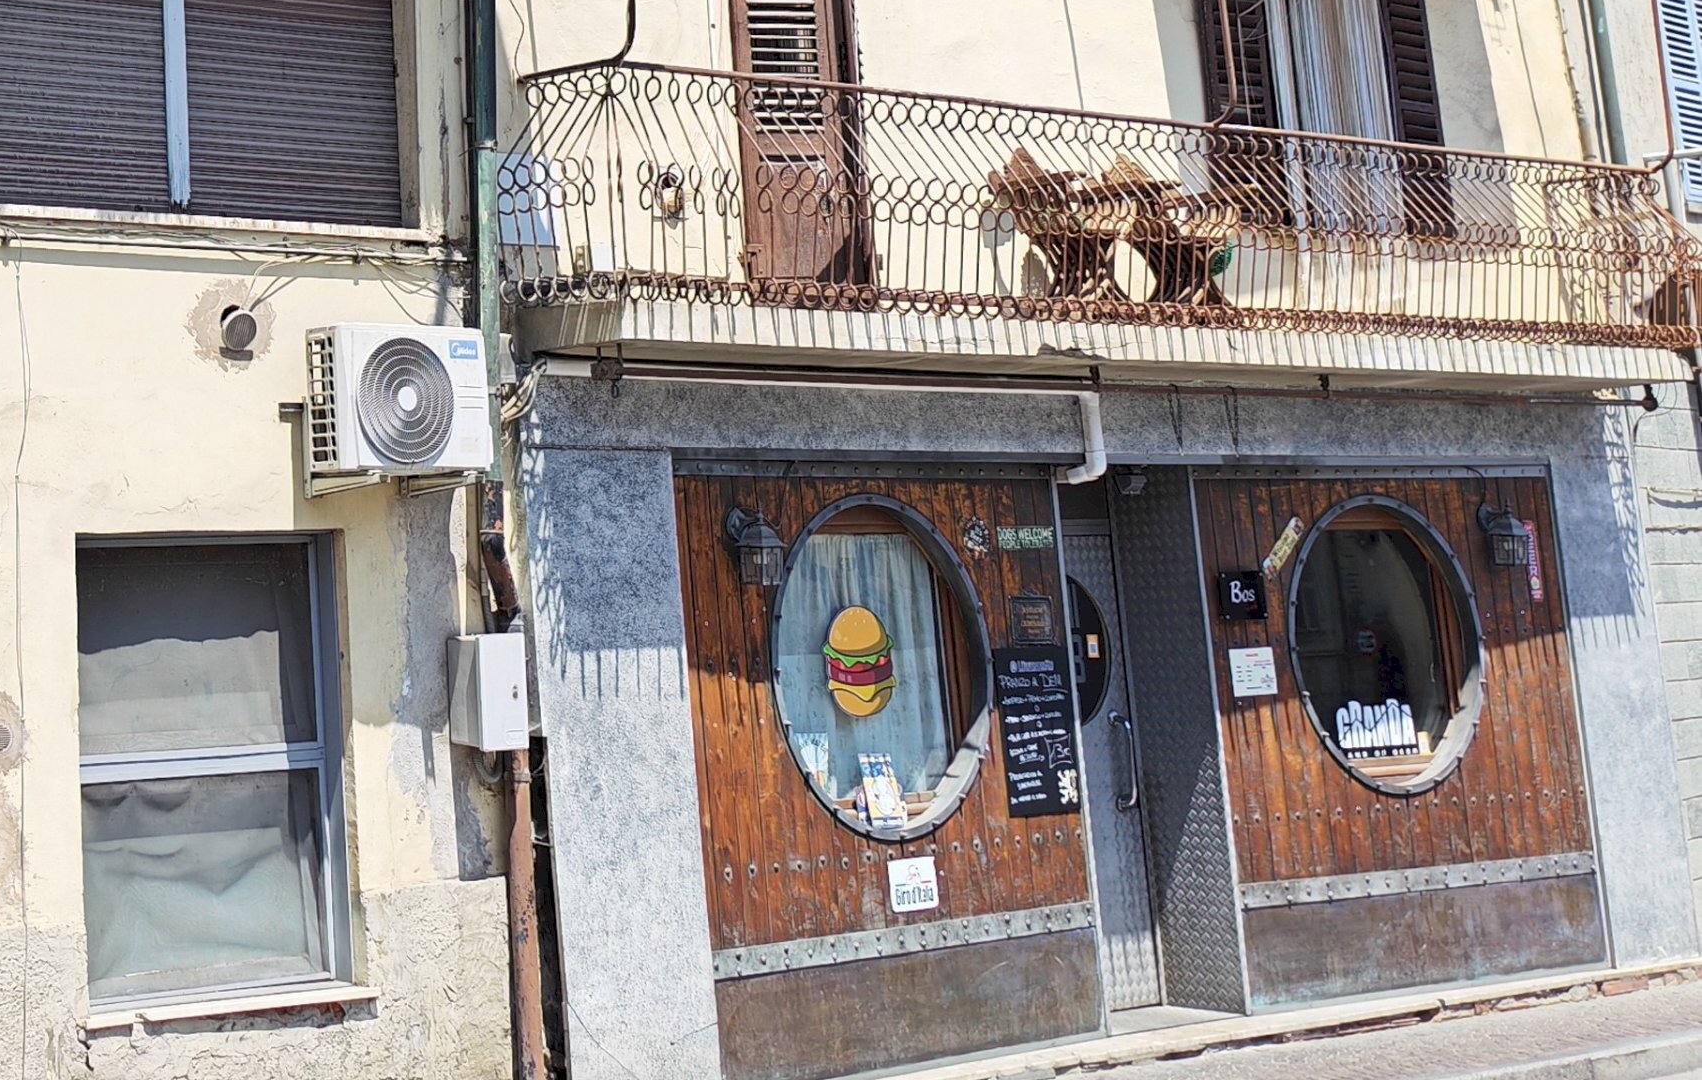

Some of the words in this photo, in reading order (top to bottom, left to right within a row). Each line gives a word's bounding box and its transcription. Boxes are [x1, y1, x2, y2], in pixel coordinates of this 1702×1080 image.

[998, 527, 1017, 540] DOGS
[1018, 527, 1053, 540] WELCOME
[1229, 580, 1256, 603] Bos
[1335, 698, 1417, 749] GRANDA
[895, 888, 911, 905] Giro
[912, 885, 934, 904] d'Italia
